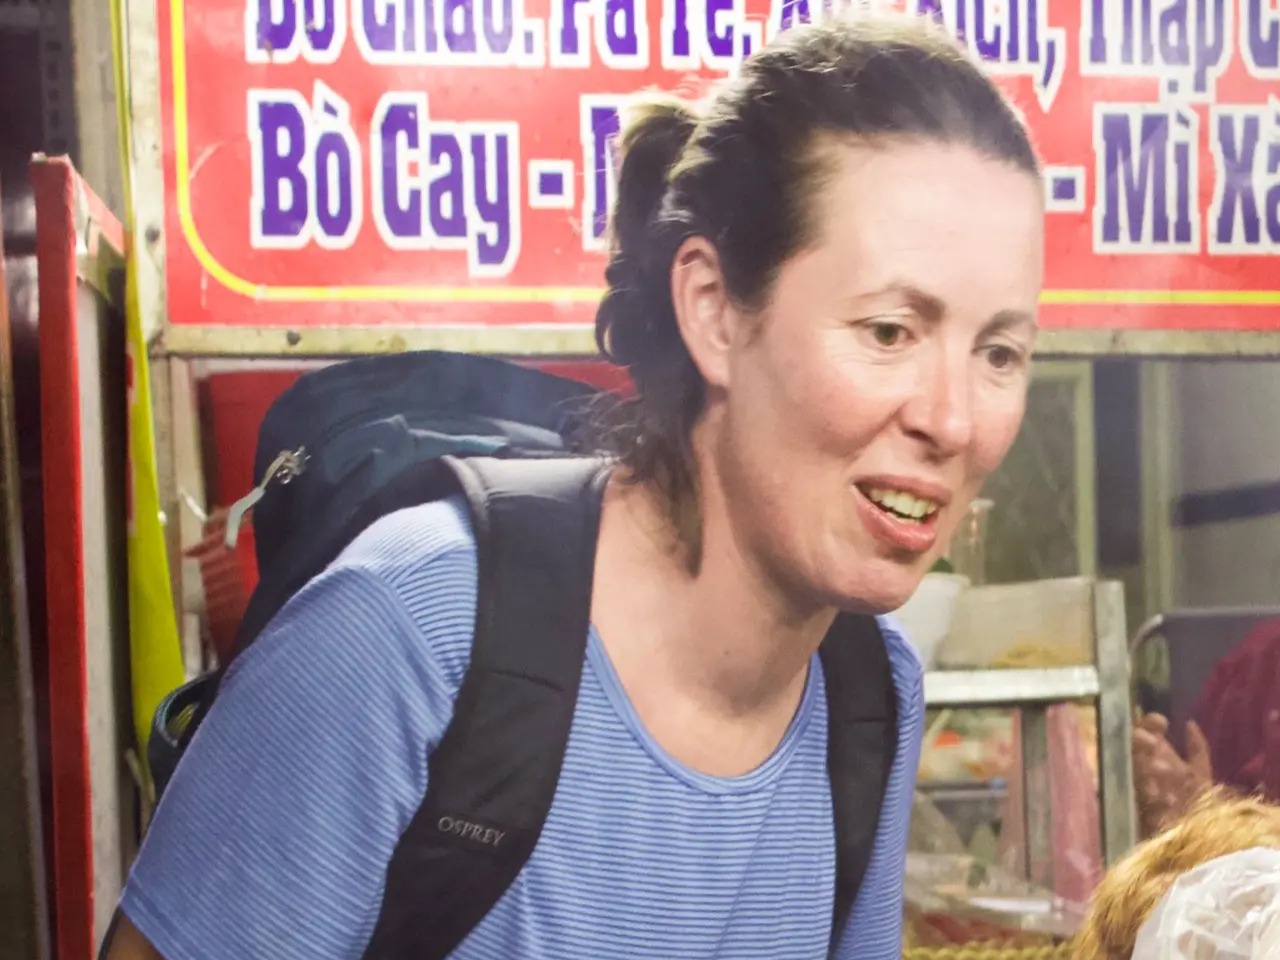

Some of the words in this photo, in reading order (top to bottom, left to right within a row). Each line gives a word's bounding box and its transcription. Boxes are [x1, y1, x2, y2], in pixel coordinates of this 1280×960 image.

[256, 97, 354, 239] Bò
[376, 101, 514, 267] Cay
[1099, 110, 1194, 245] Mì
[438, 816, 506, 846] OSPREY
